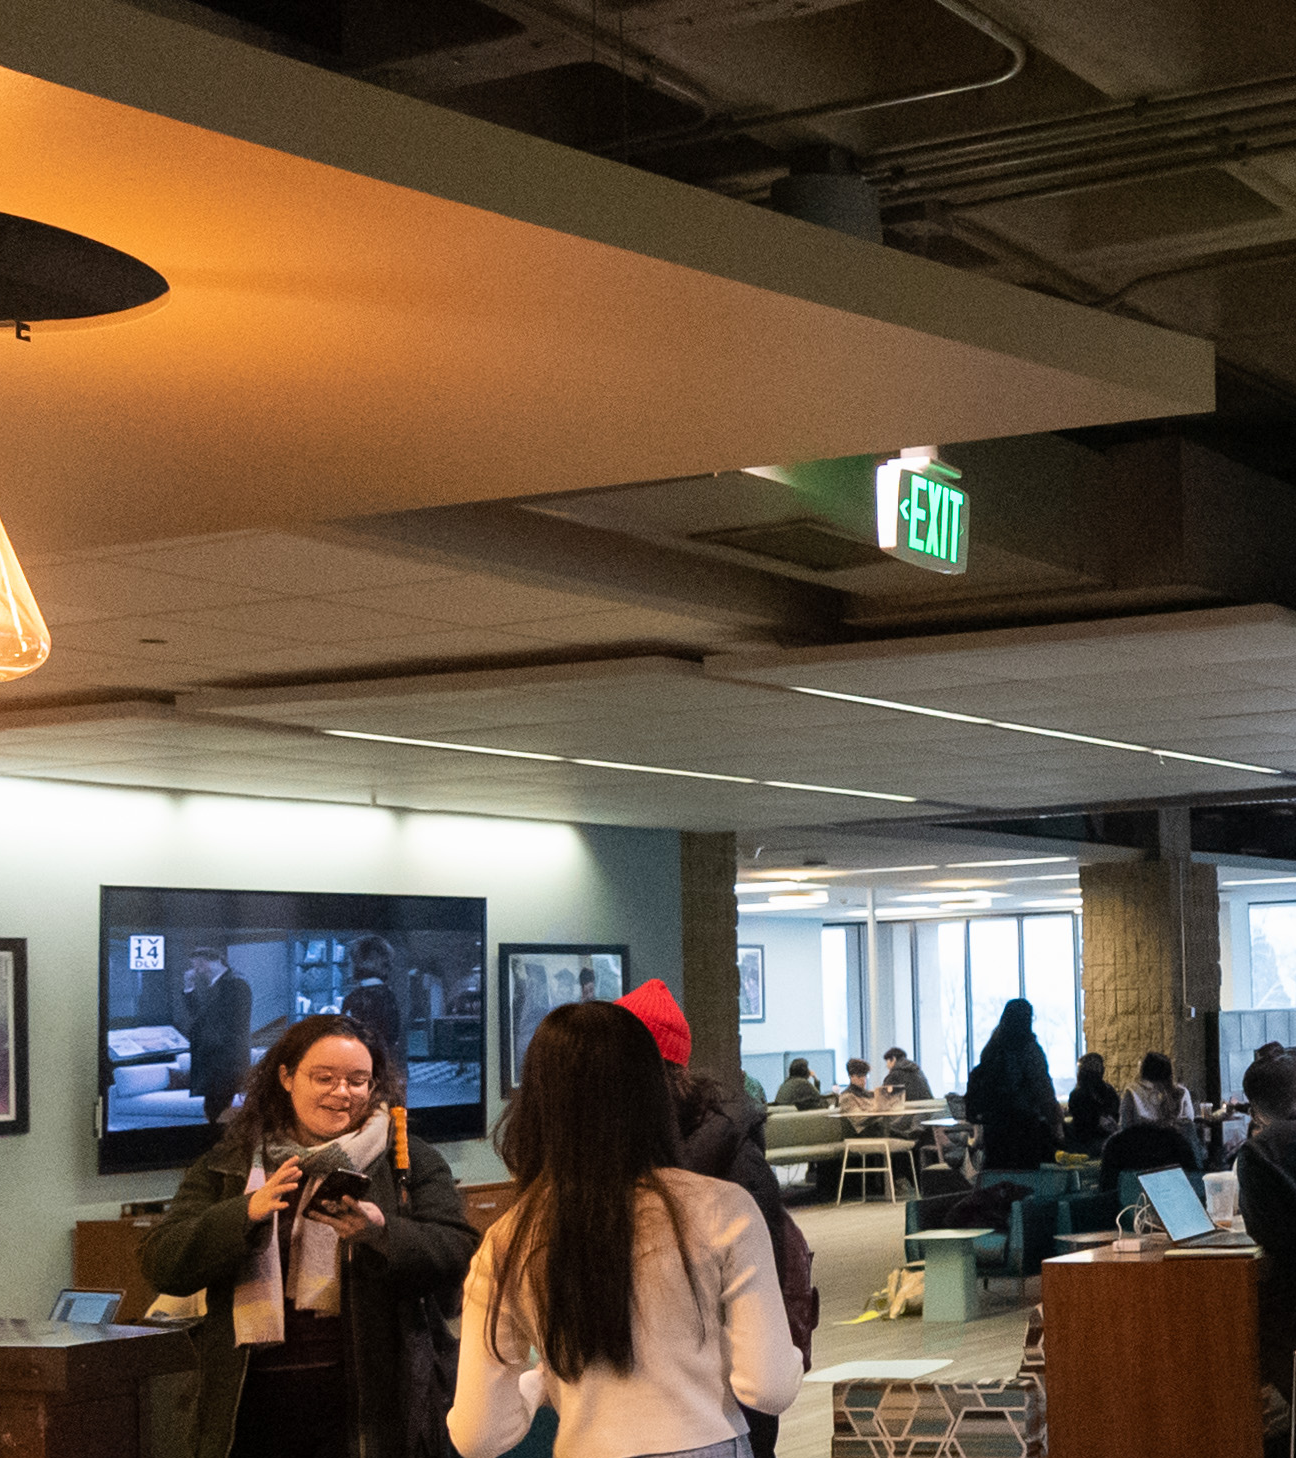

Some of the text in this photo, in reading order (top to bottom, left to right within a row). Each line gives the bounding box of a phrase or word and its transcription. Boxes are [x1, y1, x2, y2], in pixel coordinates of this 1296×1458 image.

[908, 474, 964, 563] EXIT
[133, 936, 160, 945] TV
[134, 945, 159, 959] 14
[134, 960, 160, 969] DLV
